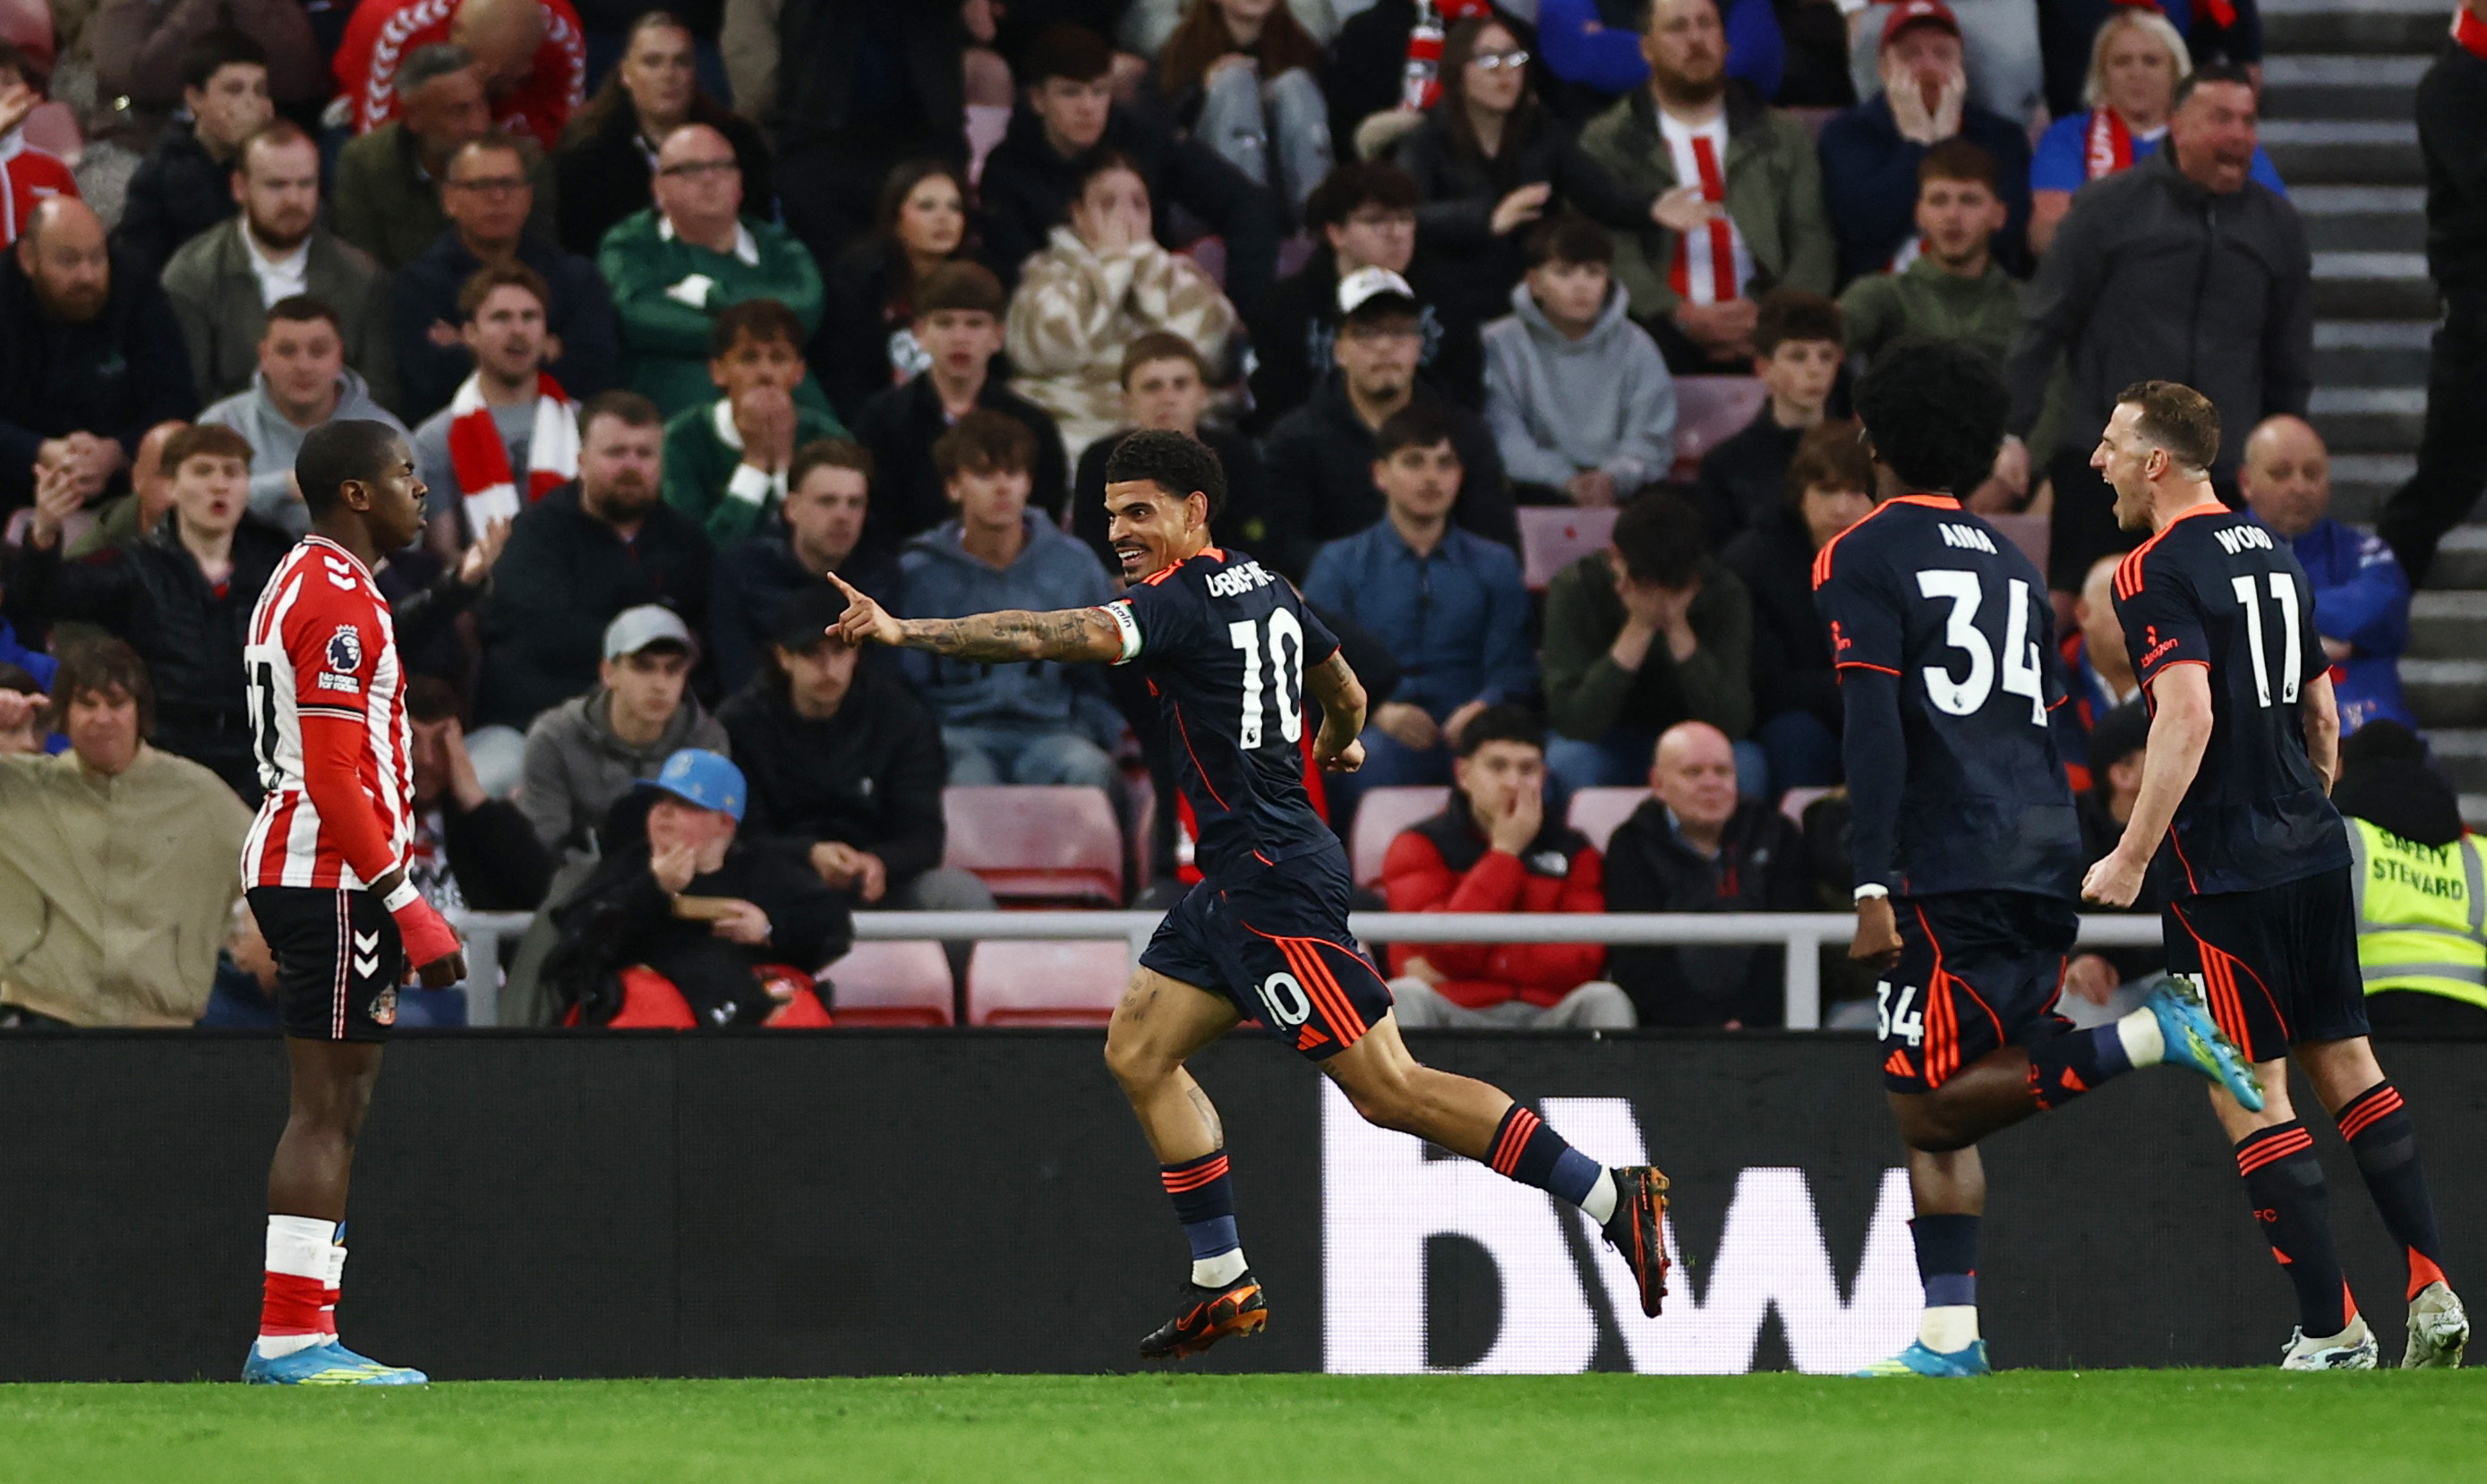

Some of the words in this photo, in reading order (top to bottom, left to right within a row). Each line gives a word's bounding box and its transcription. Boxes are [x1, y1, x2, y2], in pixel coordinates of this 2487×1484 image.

[1937, 523, 1998, 555] AINA
[2214, 525, 2273, 555] WOOD
[1916, 569, 2048, 728] 34
[2231, 572, 2302, 708] 11
[319, 671, 334, 682] No
[1228, 607, 1303, 750] 10
[1876, 979, 1925, 1046] 34
